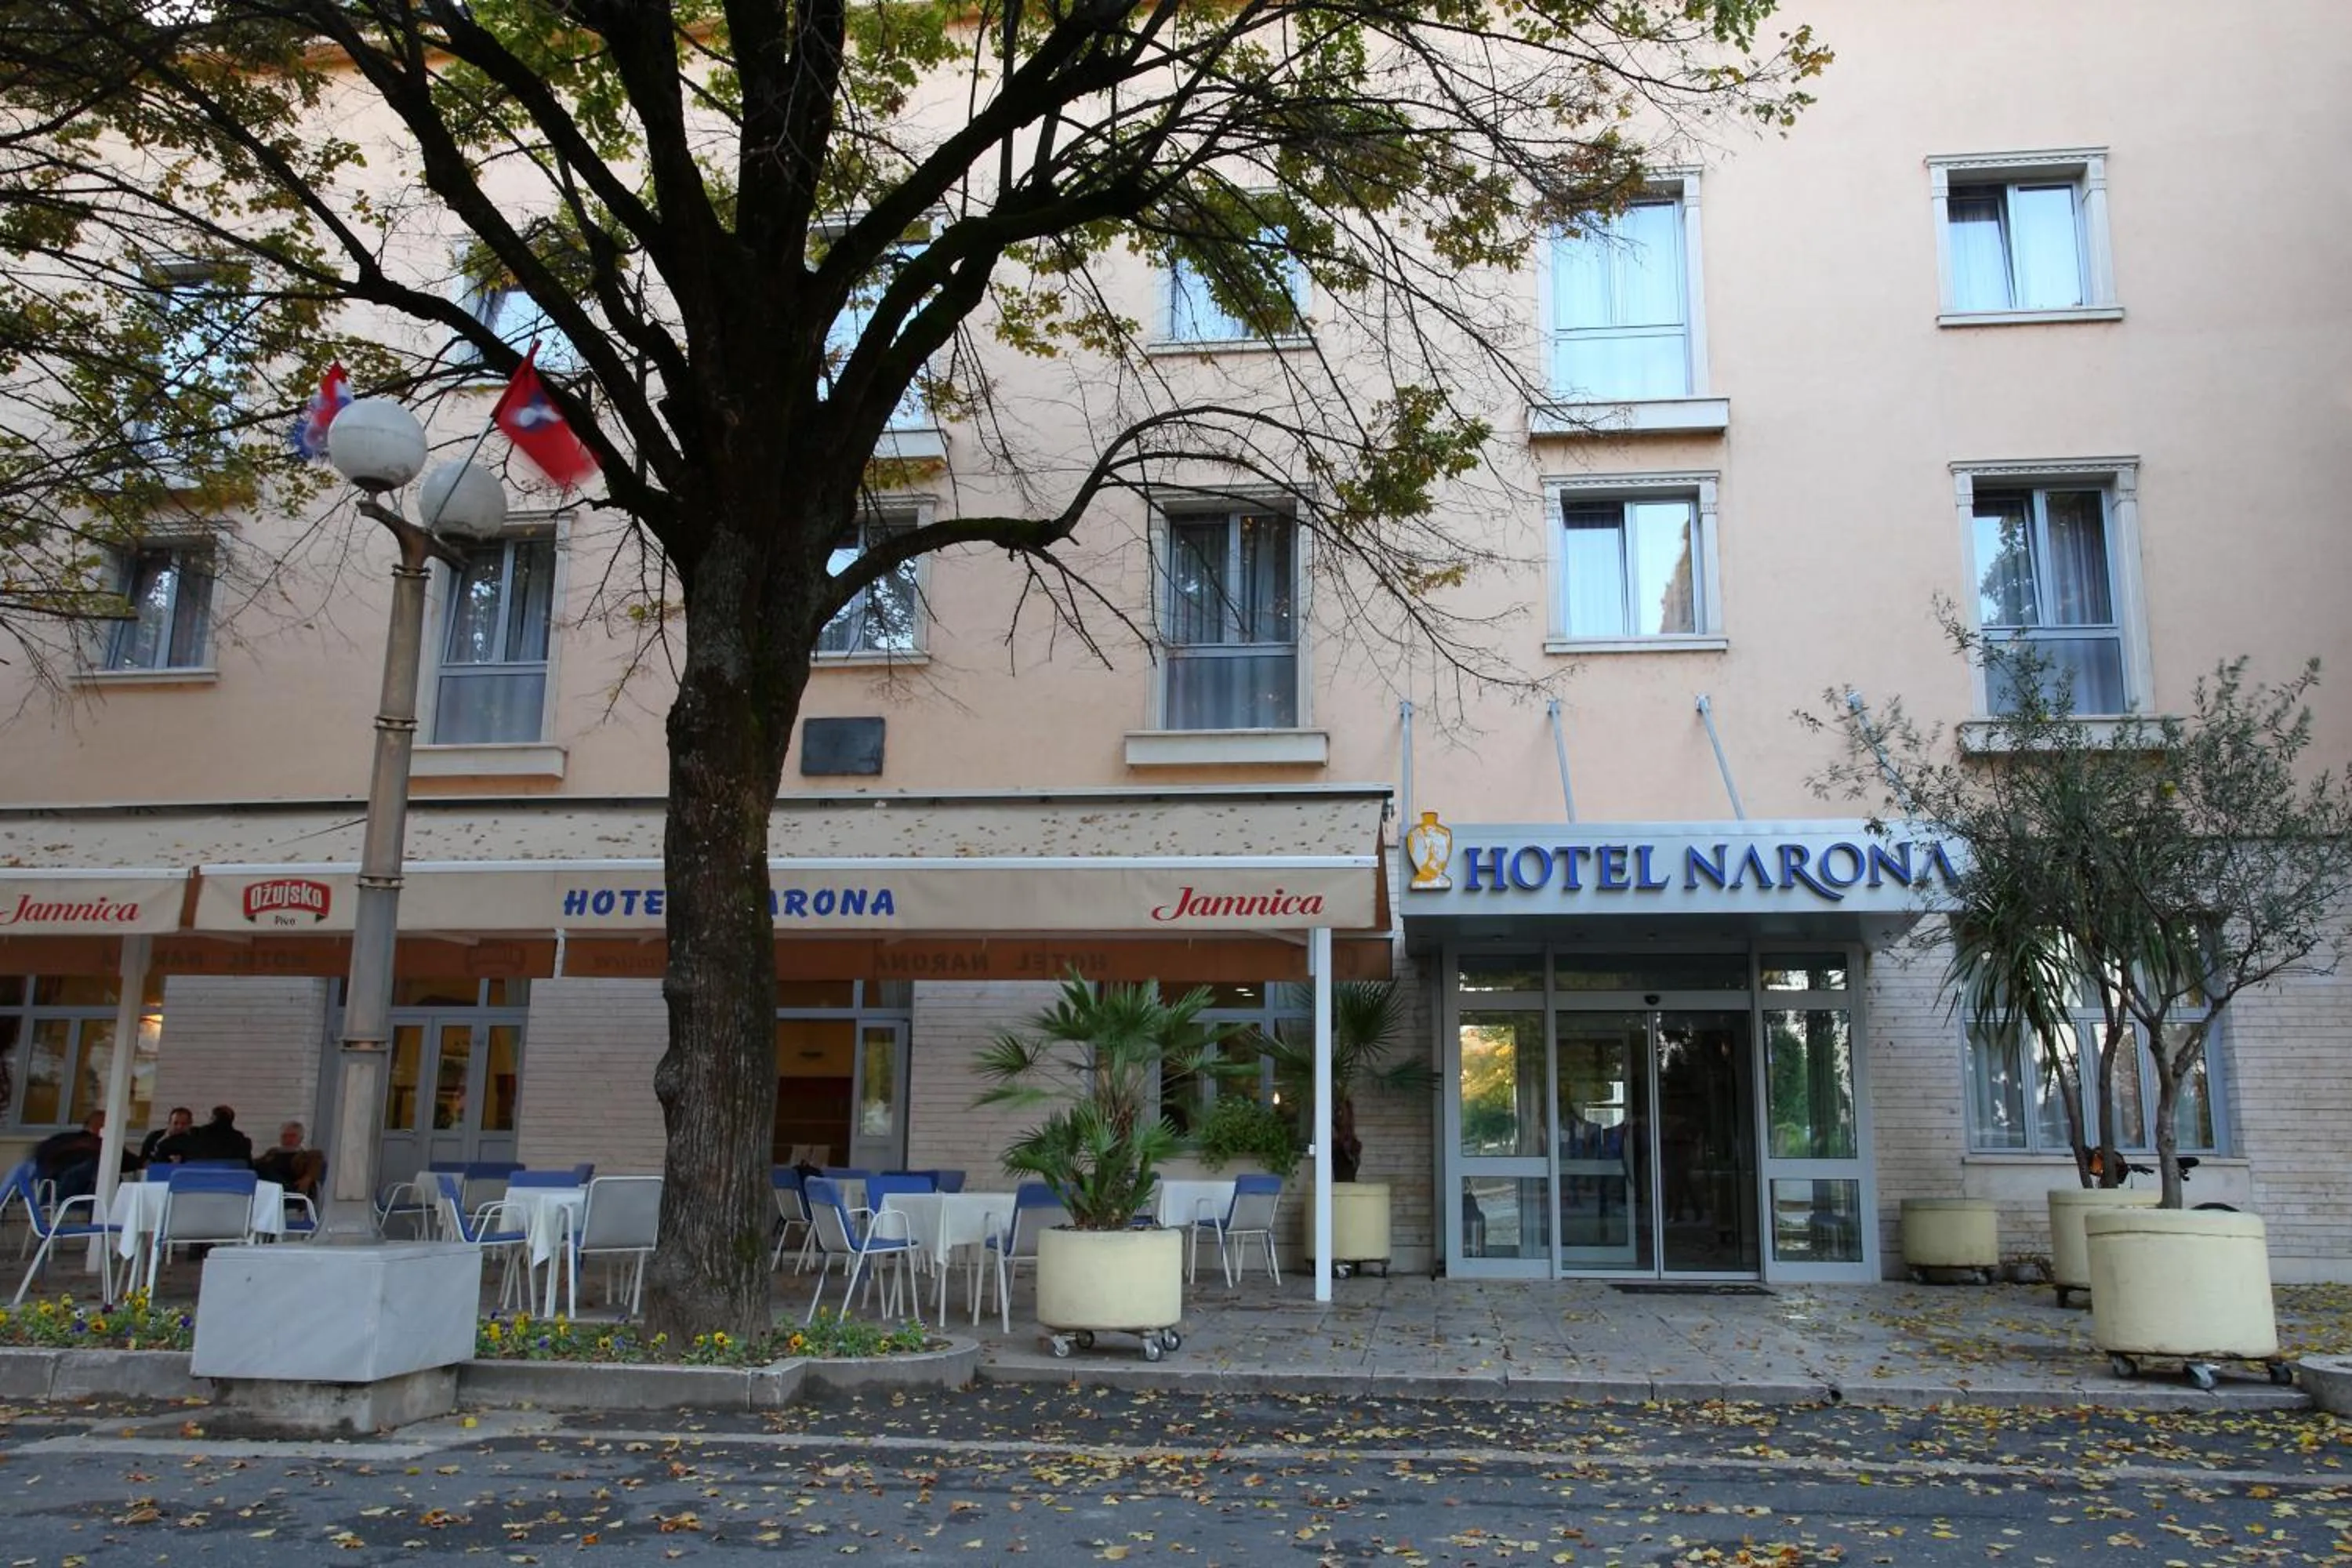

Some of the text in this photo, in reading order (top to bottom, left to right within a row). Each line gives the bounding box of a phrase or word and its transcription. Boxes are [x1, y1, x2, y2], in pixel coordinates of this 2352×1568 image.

[1465, 840, 1961, 901] HOTEL NARONA
[0, 894, 140, 926] Jamnica
[249, 880, 323, 910] Ožujsko
[564, 888, 666, 916] HOTE
[1151, 887, 1323, 921] Jamnica
[274, 916, 297, 926] Pivo
